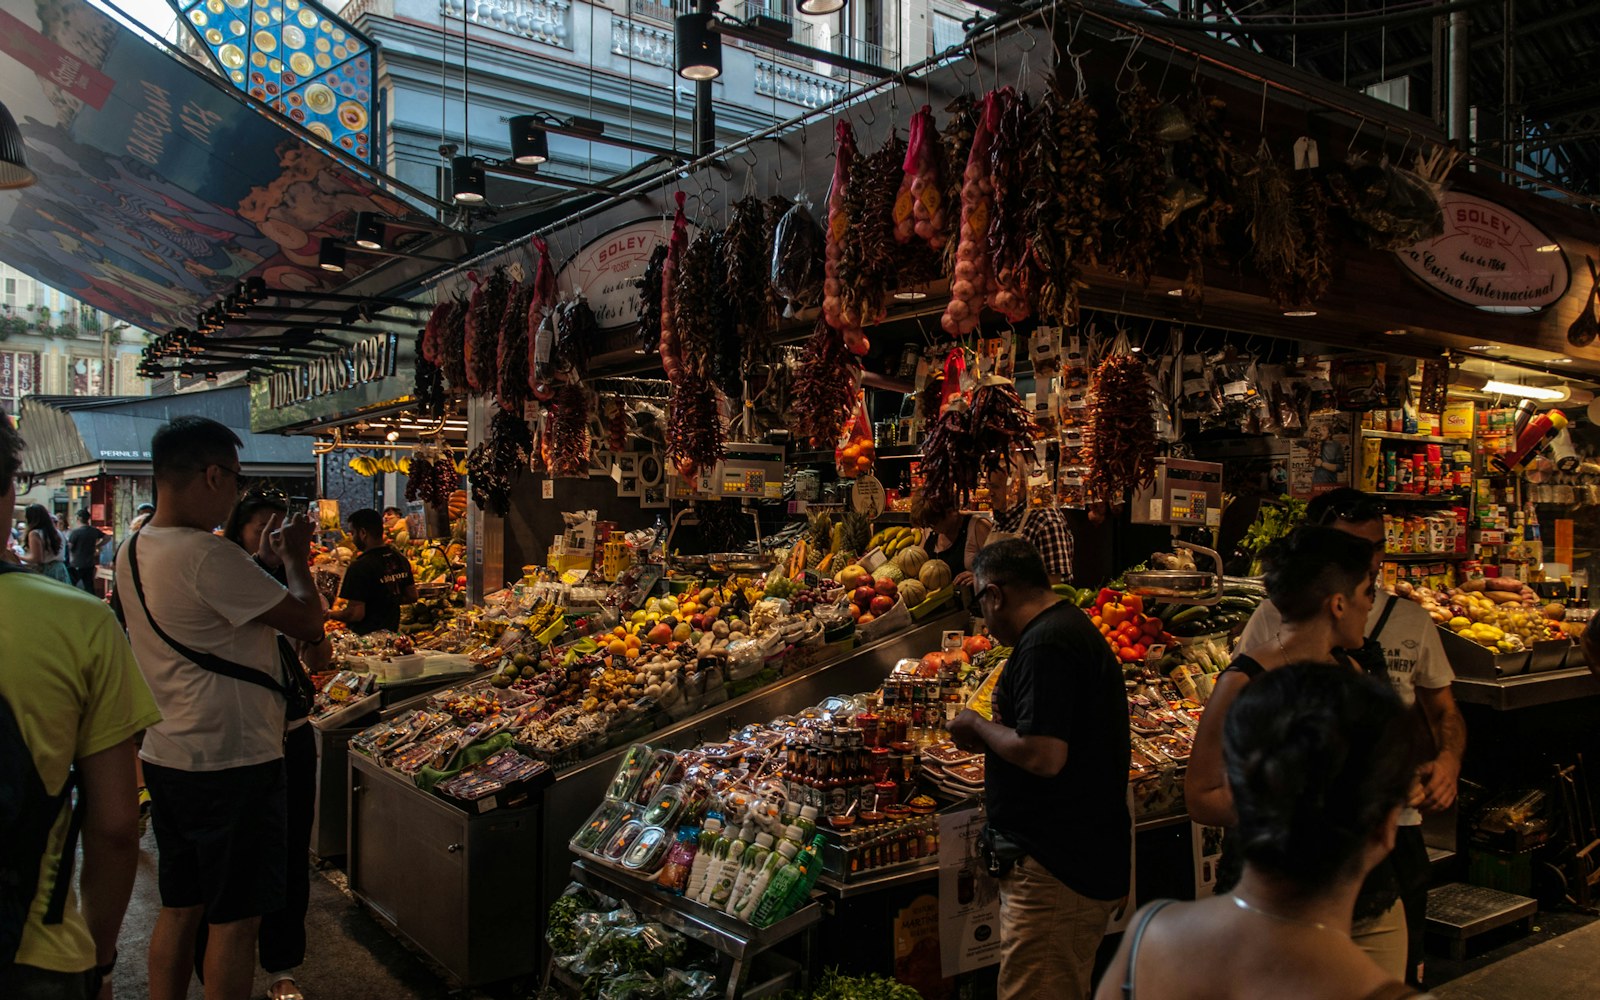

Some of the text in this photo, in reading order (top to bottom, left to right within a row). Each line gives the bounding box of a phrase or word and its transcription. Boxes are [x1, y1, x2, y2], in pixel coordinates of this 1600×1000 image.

[1456, 208, 1511, 235] SOLEY
[599, 236, 646, 262] SOLEY
[1423, 250, 1463, 289] Cuina
[1465, 274, 1555, 301] Internacional
[268, 333, 387, 409] VIDAL PONS 1897
